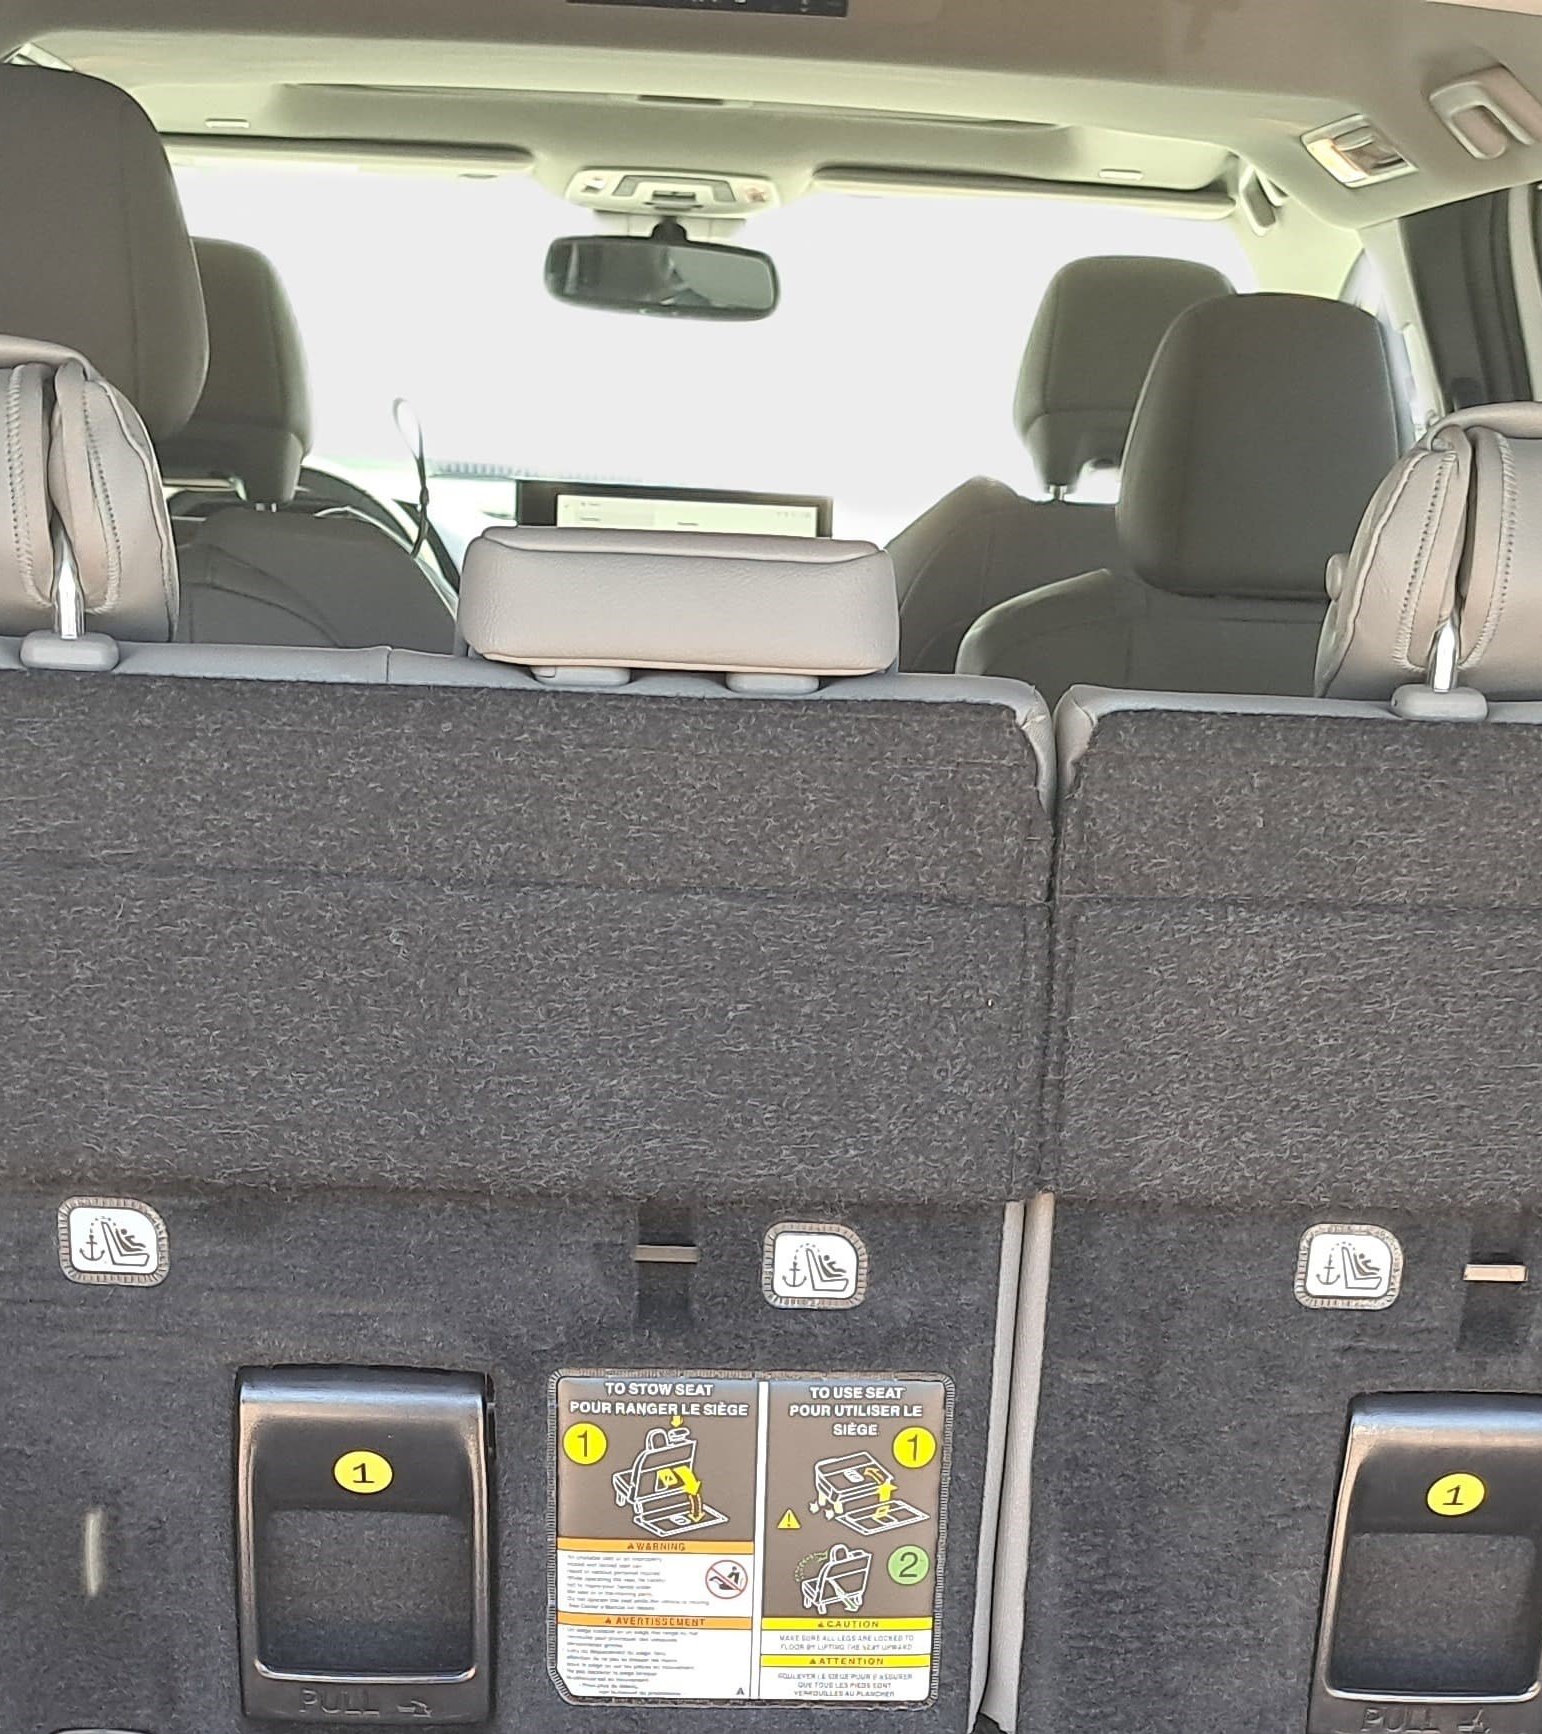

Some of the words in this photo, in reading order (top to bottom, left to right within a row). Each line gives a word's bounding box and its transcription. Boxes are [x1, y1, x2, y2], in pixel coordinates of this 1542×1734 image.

[605, 1382, 625, 1395] TO
[628, 1383, 672, 1396] STOW
[675, 1384, 714, 1397] SEAT
[809, 1387, 830, 1399] TO
[833, 1387, 863, 1399] USE
[865, 1387, 905, 1399] SEAT
[570, 1401, 612, 1414] POUR
[615, 1402, 678, 1416] RANGER
[681, 1403, 700, 1416] LE
[703, 1402, 749, 1417] SIÈGE
[789, 1405, 831, 1417] POUR
[834, 1405, 901, 1417] UTILISER
[903, 1405, 923, 1417] LE
[833, 1422, 879, 1436] SIÈGE
[577, 1430, 588, 1458] 1
[907, 1434, 918, 1461] 1
[352, 1463, 376, 1484] 1
[1443, 1483, 1465, 1506] 1
[636, 1543, 687, 1552] WARNING
[898, 1551, 919, 1578] 2
[615, 1617, 706, 1627] AVERTISSEMENT
[826, 1620, 880, 1628] CAUTION
[818, 1657, 884, 1665] ATTENTION
[298, 1688, 381, 1718] PULL
[1360, 1707, 1441, 1734] PULL
